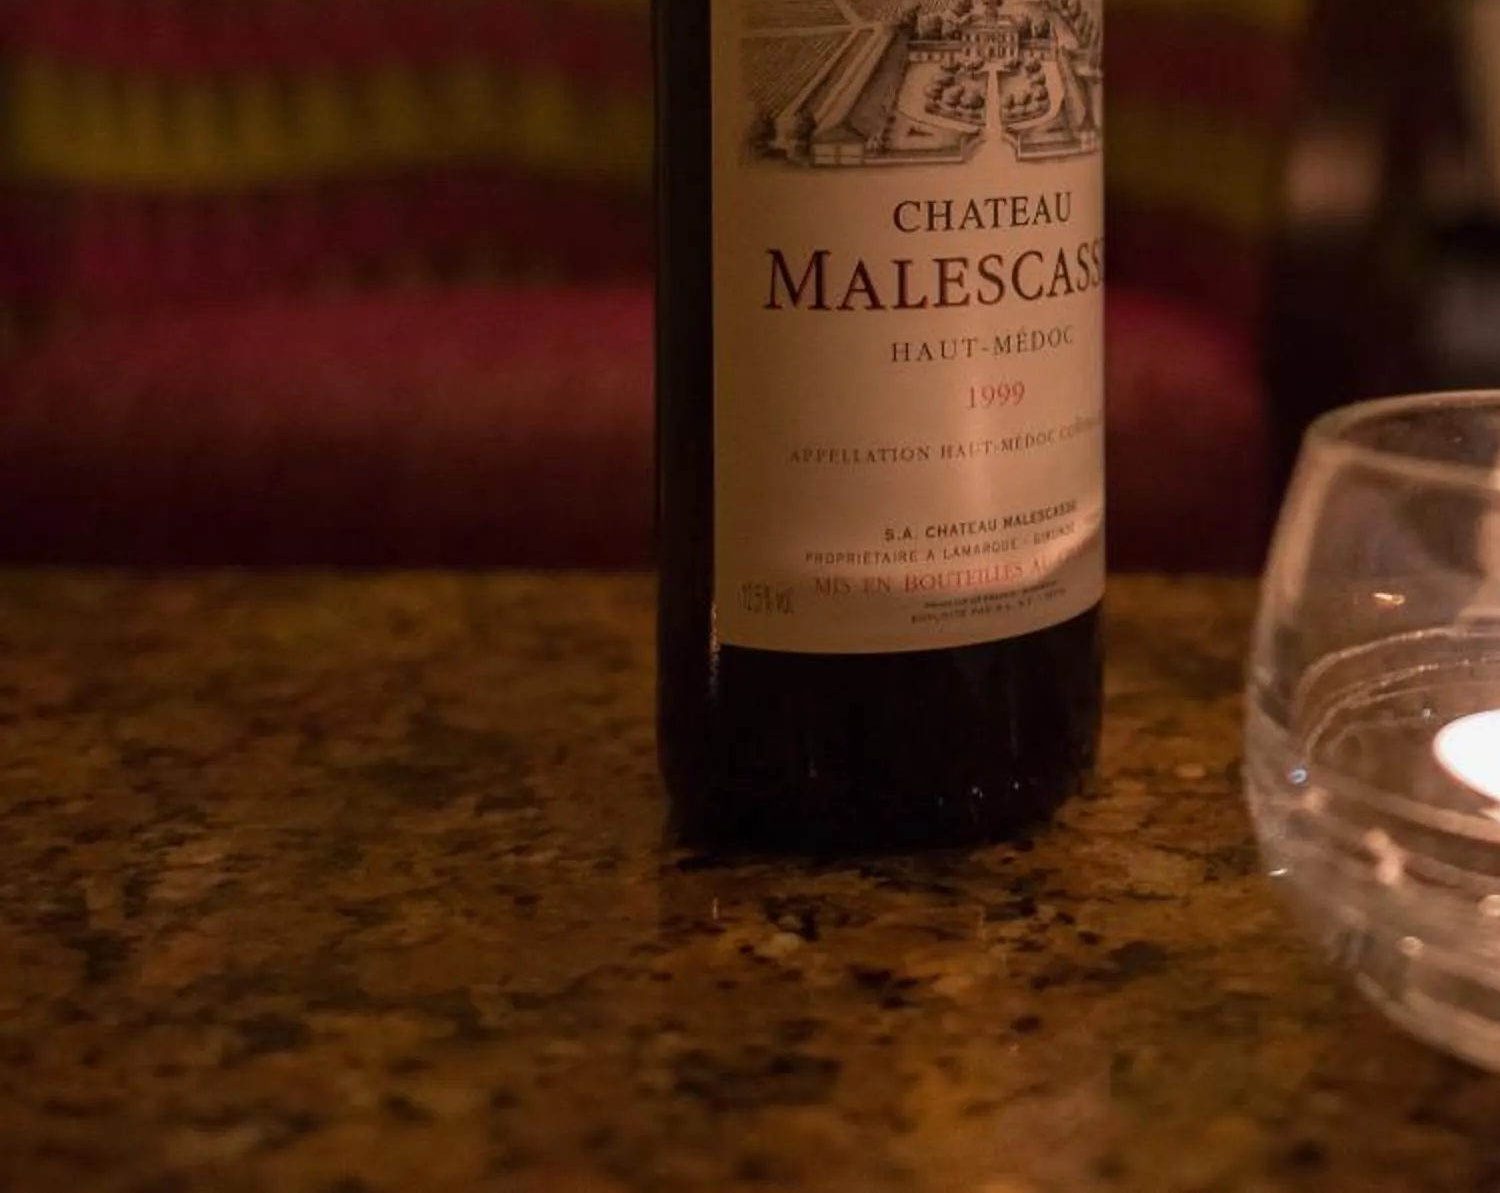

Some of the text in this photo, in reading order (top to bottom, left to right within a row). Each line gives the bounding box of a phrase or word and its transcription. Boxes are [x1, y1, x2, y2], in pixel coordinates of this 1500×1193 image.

[893, 191, 1073, 232] CHATEAU
[763, 237, 1103, 311] MALESCASS
[890, 324, 1075, 363] HAUT-MÉDOC
[968, 381, 1026, 409] 1999
[789, 445, 930, 465] APPELLATION
[925, 518, 997, 540] CHATEAU
[815, 576, 851, 597] MIS
